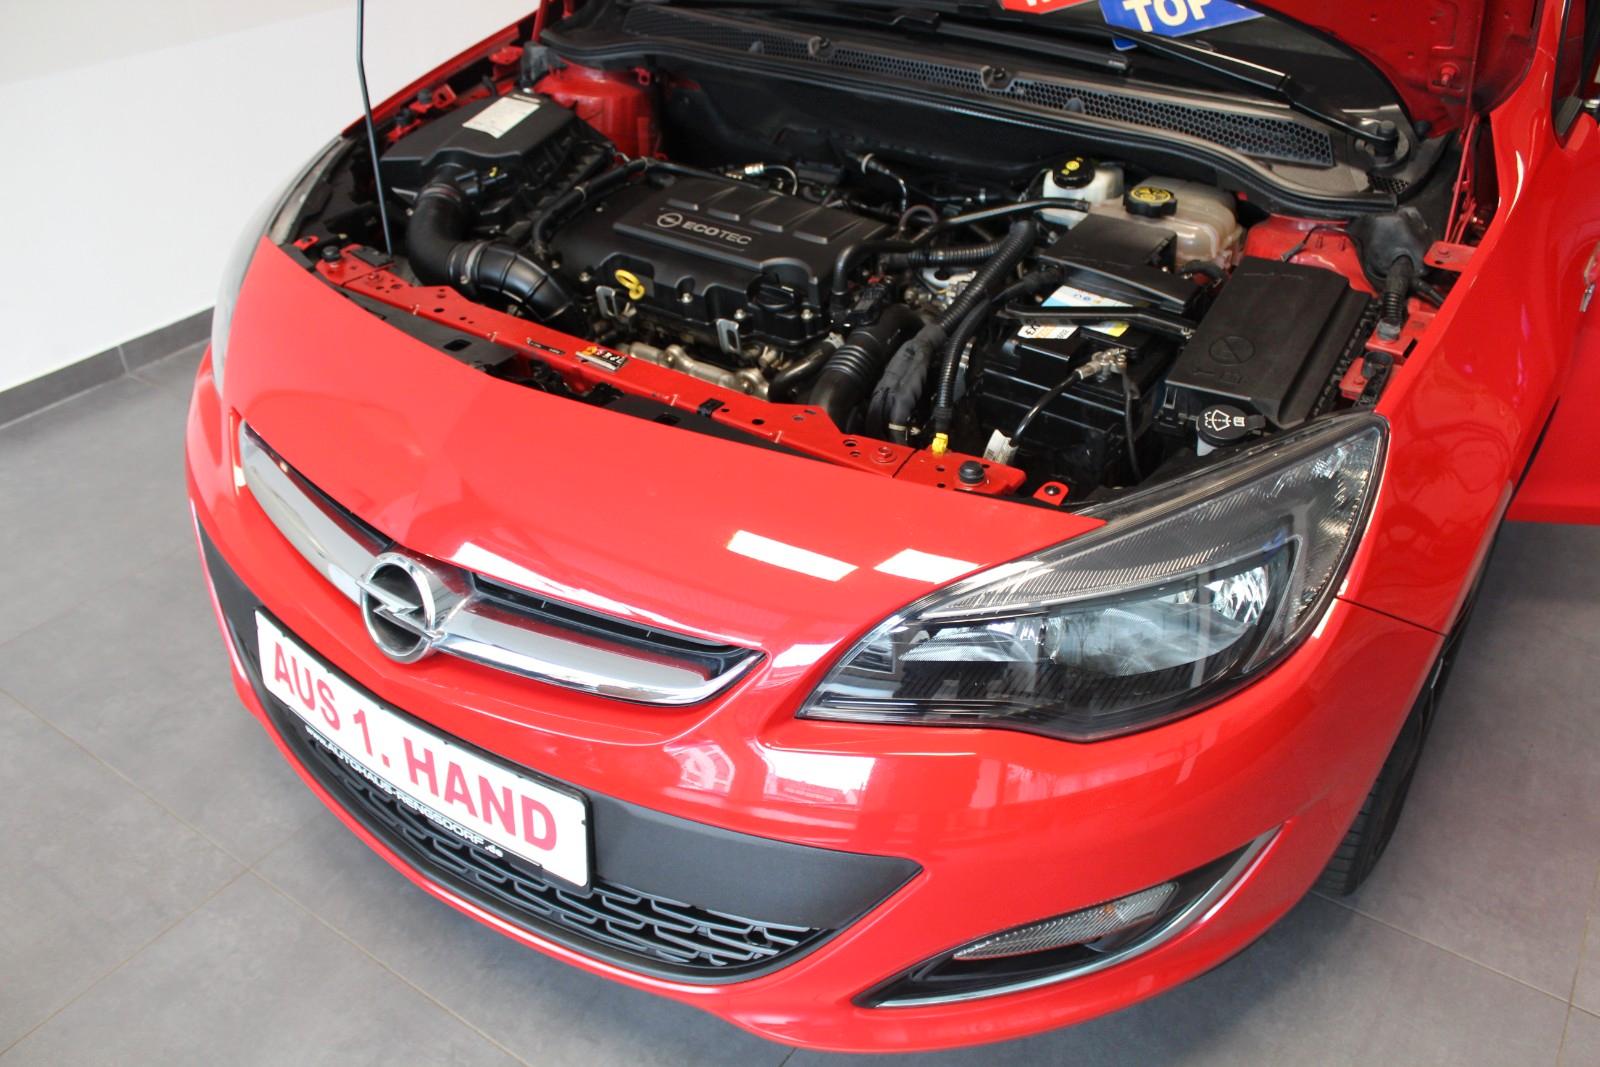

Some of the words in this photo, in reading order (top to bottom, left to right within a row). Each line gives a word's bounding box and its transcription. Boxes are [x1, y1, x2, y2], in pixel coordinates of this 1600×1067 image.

[1123, 0, 1212, 32] TOP
[682, 221, 752, 245] ECOTEC
[274, 642, 341, 731] AUS
[353, 709, 390, 767] 1.
[403, 736, 557, 851] HAND
